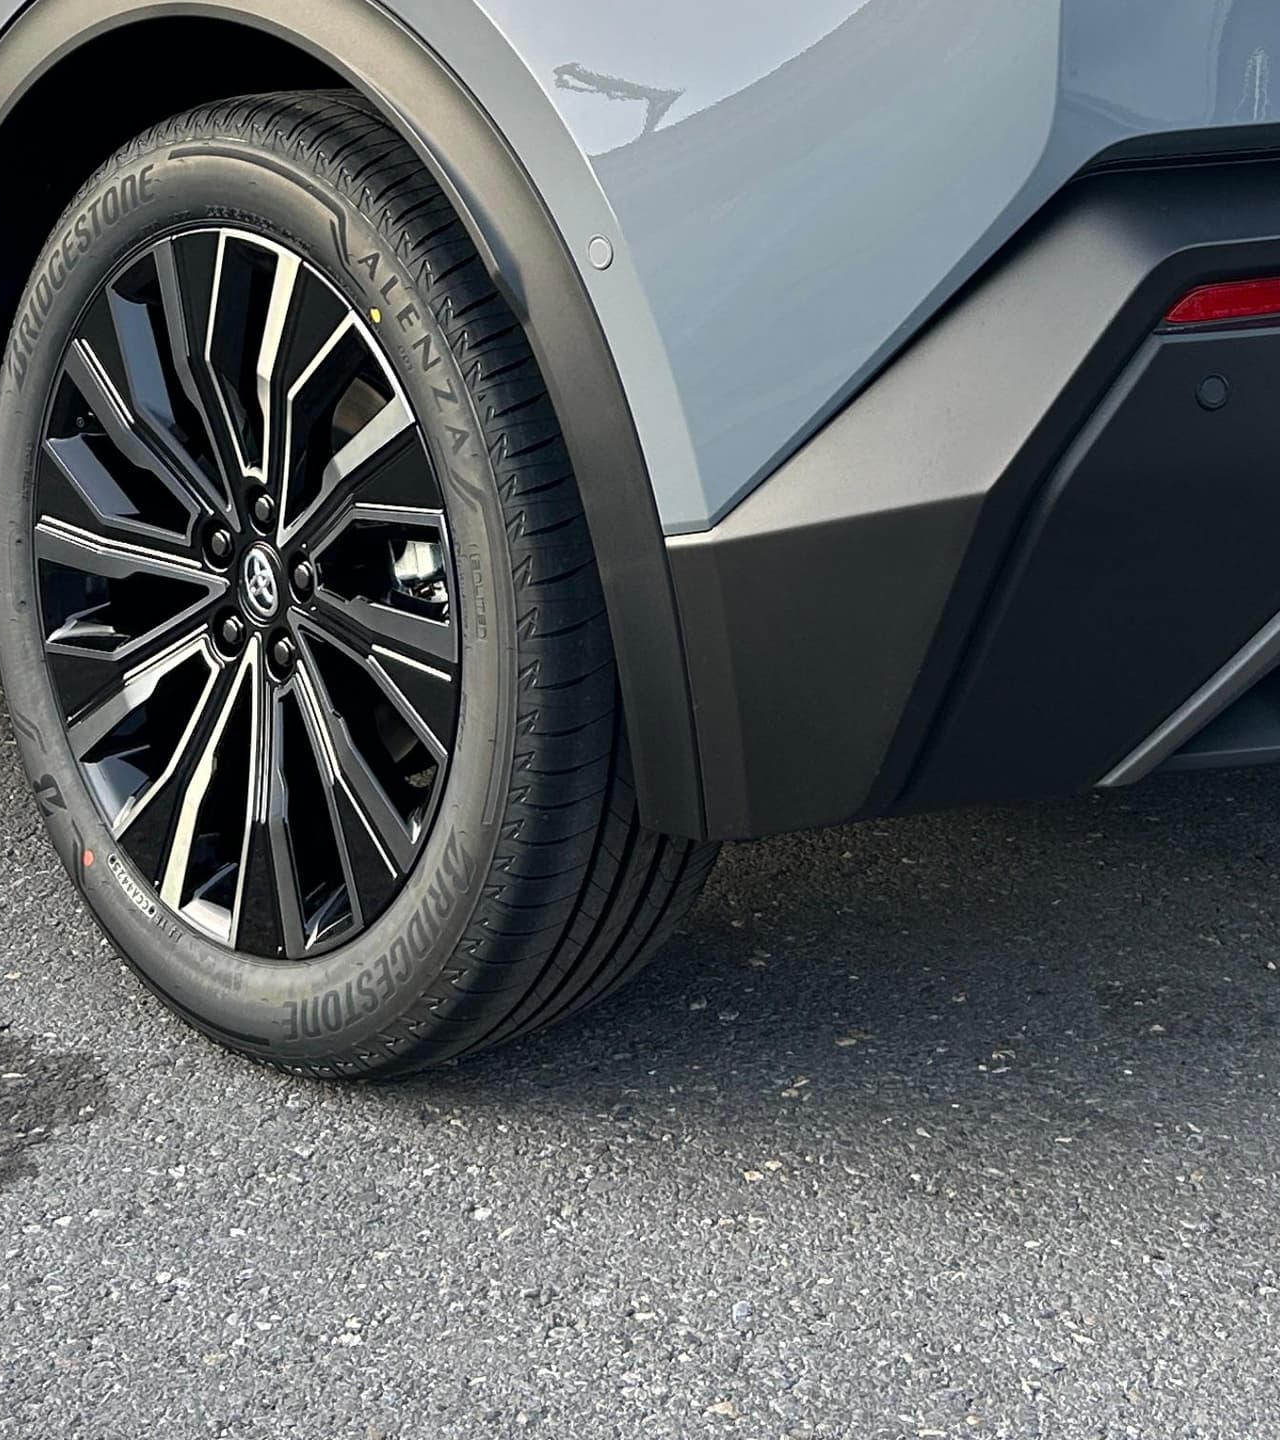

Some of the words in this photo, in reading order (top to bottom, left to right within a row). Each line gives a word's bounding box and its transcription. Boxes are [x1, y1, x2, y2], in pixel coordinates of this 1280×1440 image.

[7, 163, 154, 390] BRIDGESTONE
[357, 250, 471, 457] ALENZA
[280, 824, 474, 1042] BRIDGESTONE
